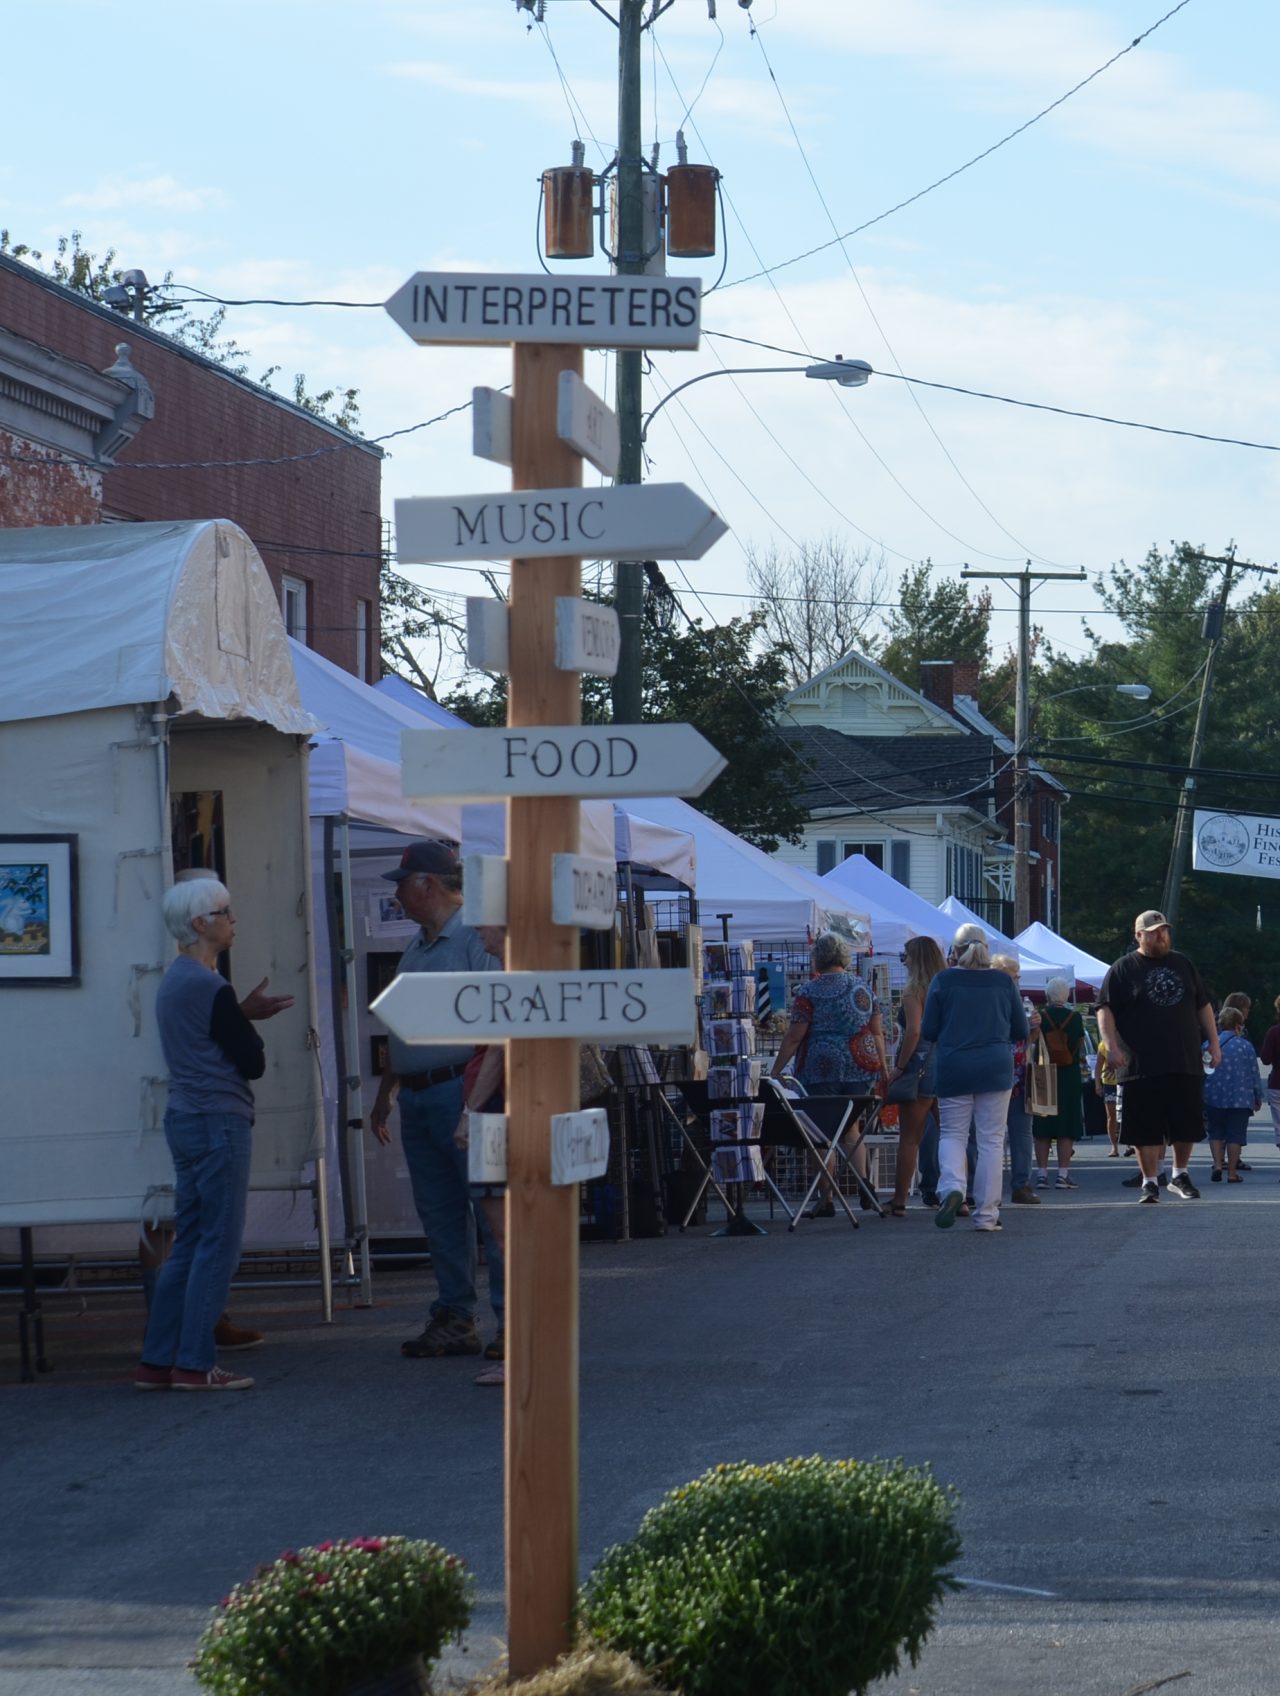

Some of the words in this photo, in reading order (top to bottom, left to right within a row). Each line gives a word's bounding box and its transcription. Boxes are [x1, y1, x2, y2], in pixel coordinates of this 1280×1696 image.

[412, 285, 697, 327] INTERPRETERS
[452, 500, 606, 546] MUSIC
[503, 737, 638, 778] FOOD
[454, 981, 647, 1024] CRAFTS
